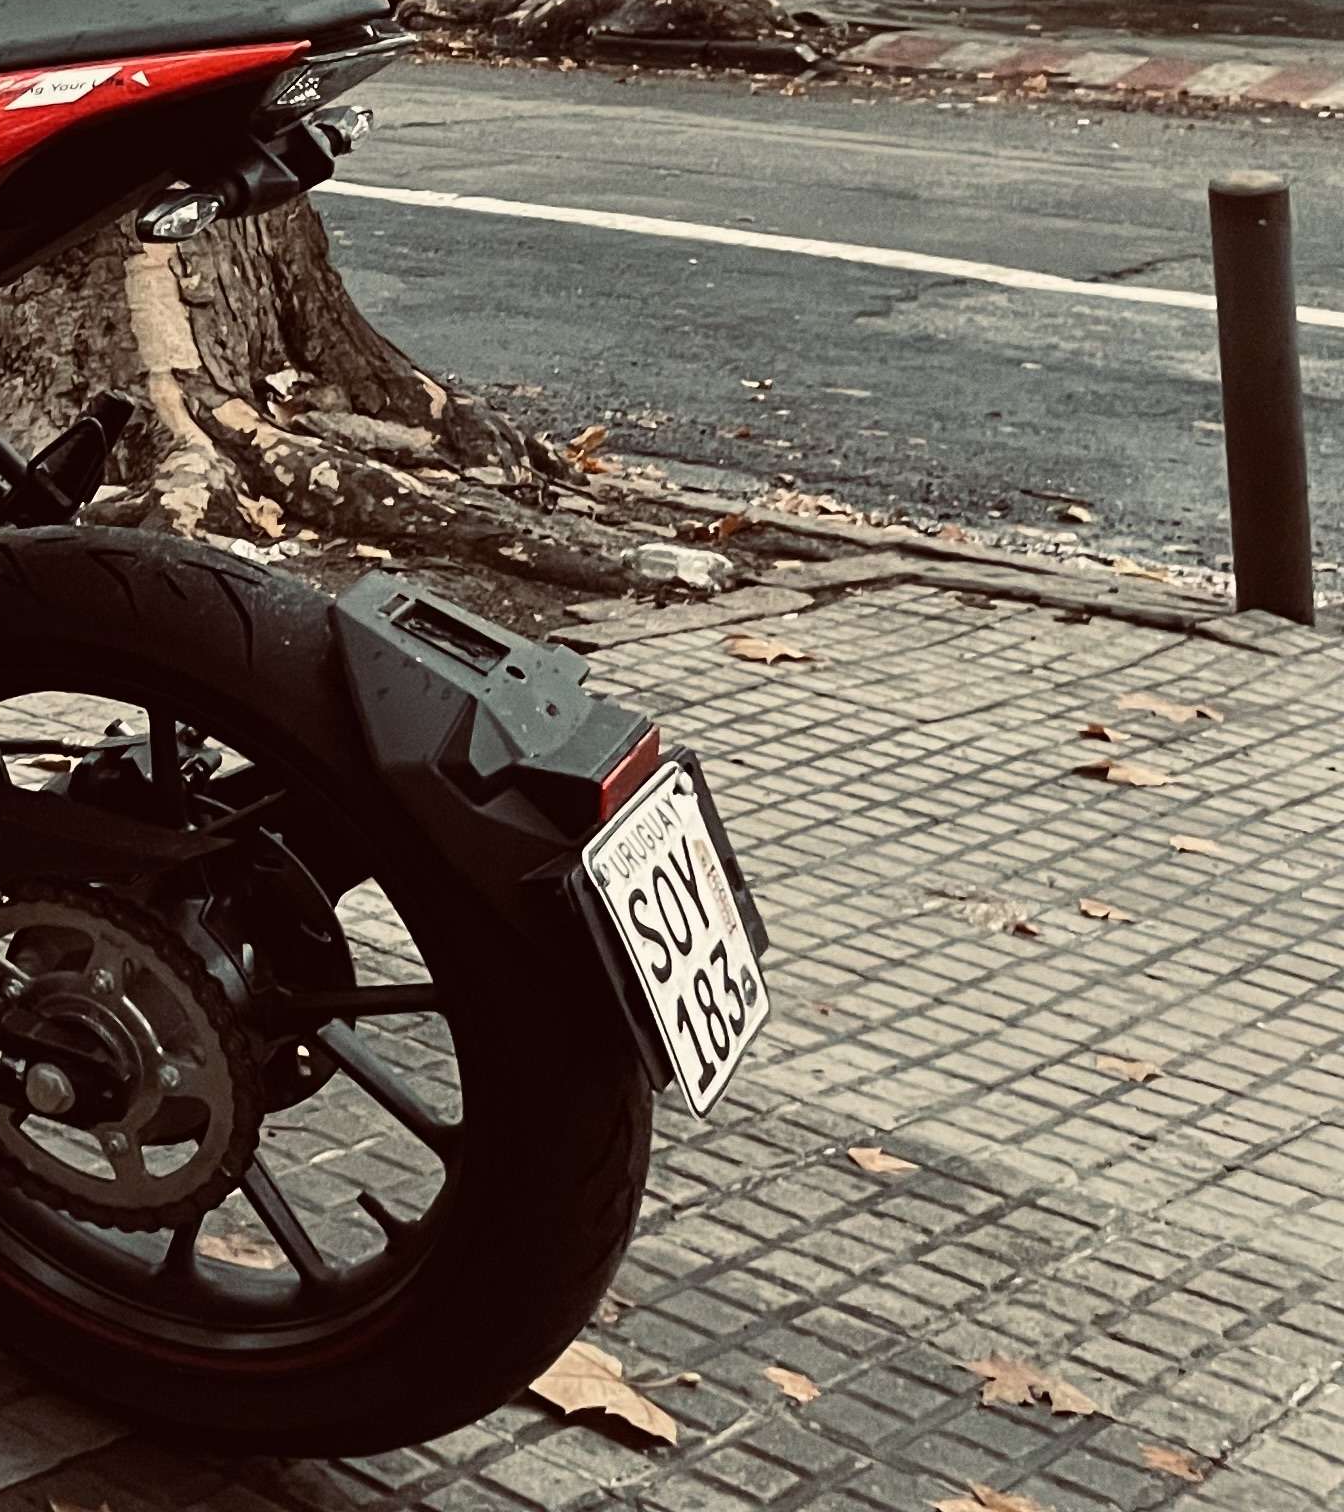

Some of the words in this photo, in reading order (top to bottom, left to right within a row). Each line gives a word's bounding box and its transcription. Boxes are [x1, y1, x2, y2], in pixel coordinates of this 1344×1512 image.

[609, 791, 683, 879] URUGUAY
[628, 835, 710, 984] SOY
[676, 940, 746, 1095] 183
